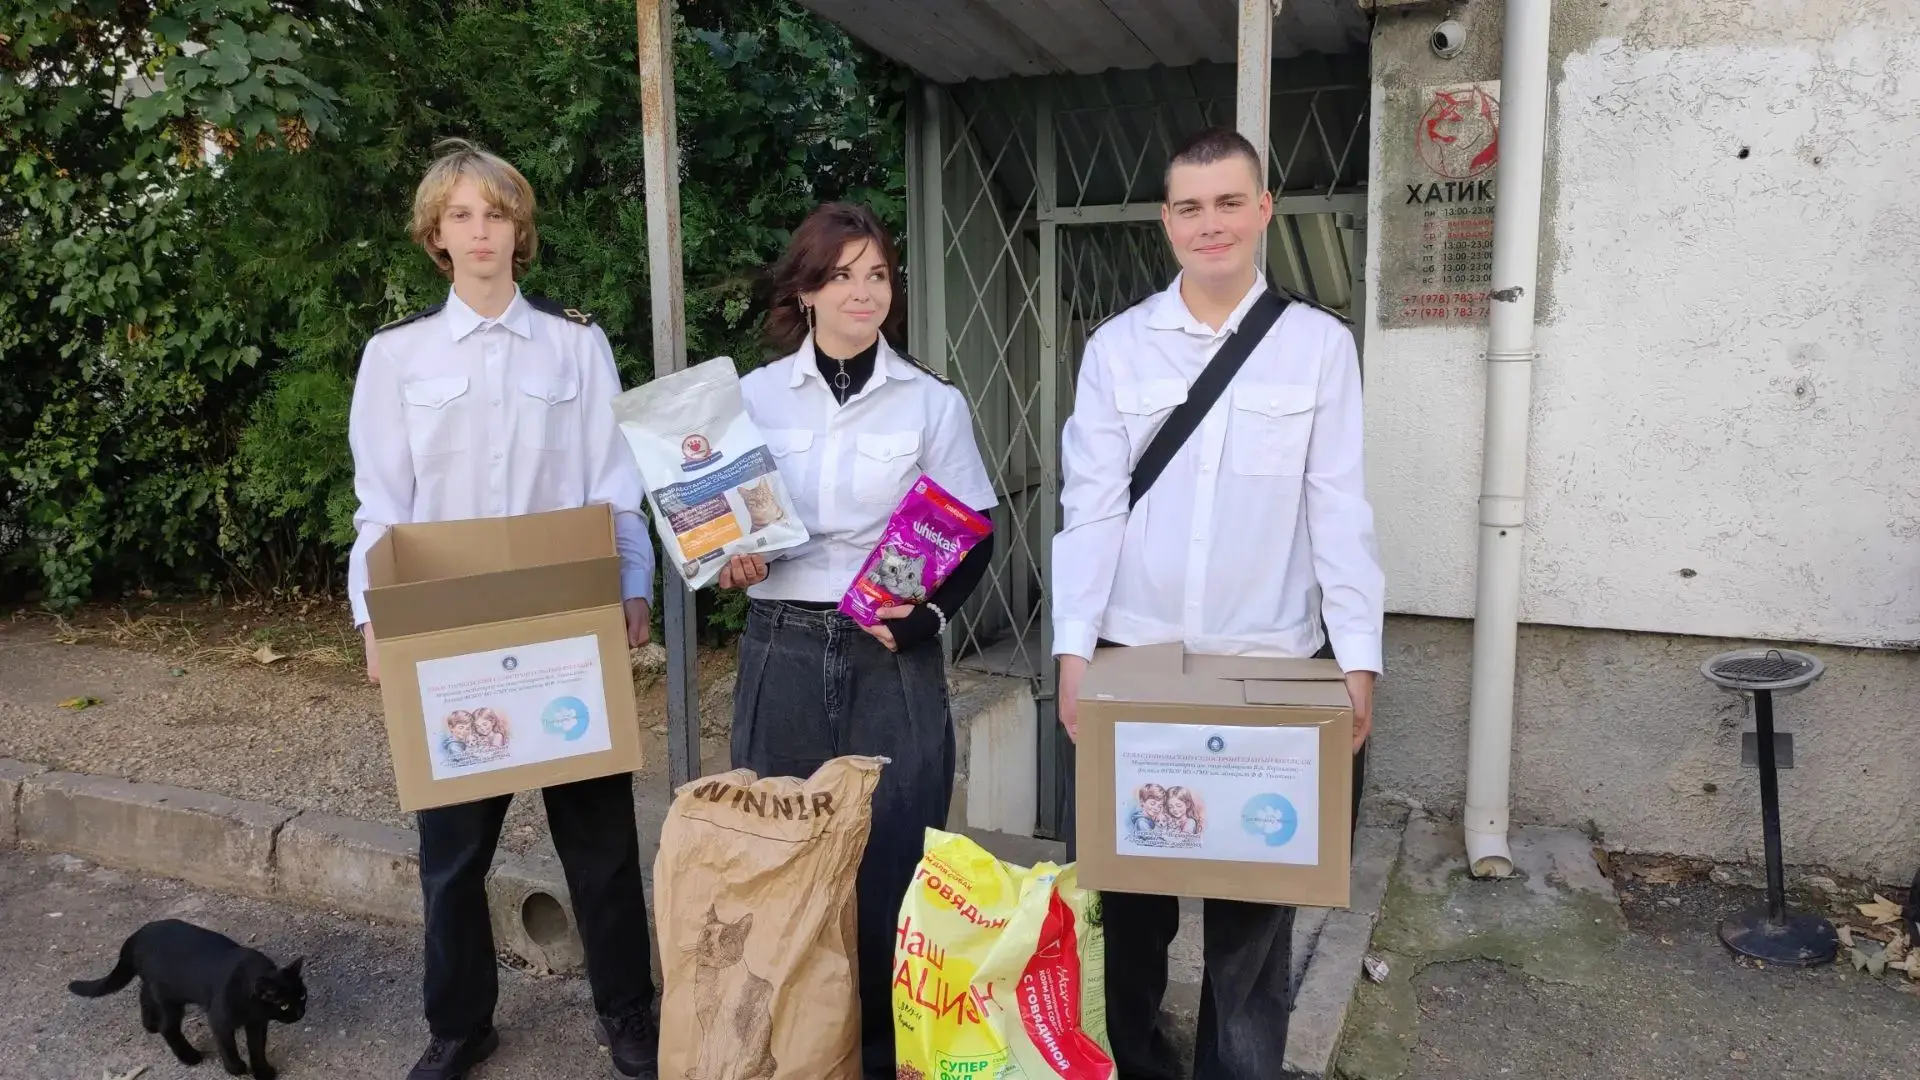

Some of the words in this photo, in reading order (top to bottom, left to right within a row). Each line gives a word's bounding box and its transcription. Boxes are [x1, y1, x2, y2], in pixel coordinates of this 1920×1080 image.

[1406, 179, 1494, 204] ХАТИК
[1447, 231, 1493, 239] выходно
[913, 520, 957, 553] whiskas
[916, 868, 1011, 929] ГОВЯДИН
[893, 954, 1004, 1025] АЦИОН
[1024, 974, 1034, 984] С
[1039, 969, 1049, 993] КОРМ
[1043, 993, 1052, 1011] ДЛЯ
[1026, 986, 1071, 1071] ГОВЯДИНОЙ
[939, 1059, 989, 1074] СУПЕР
